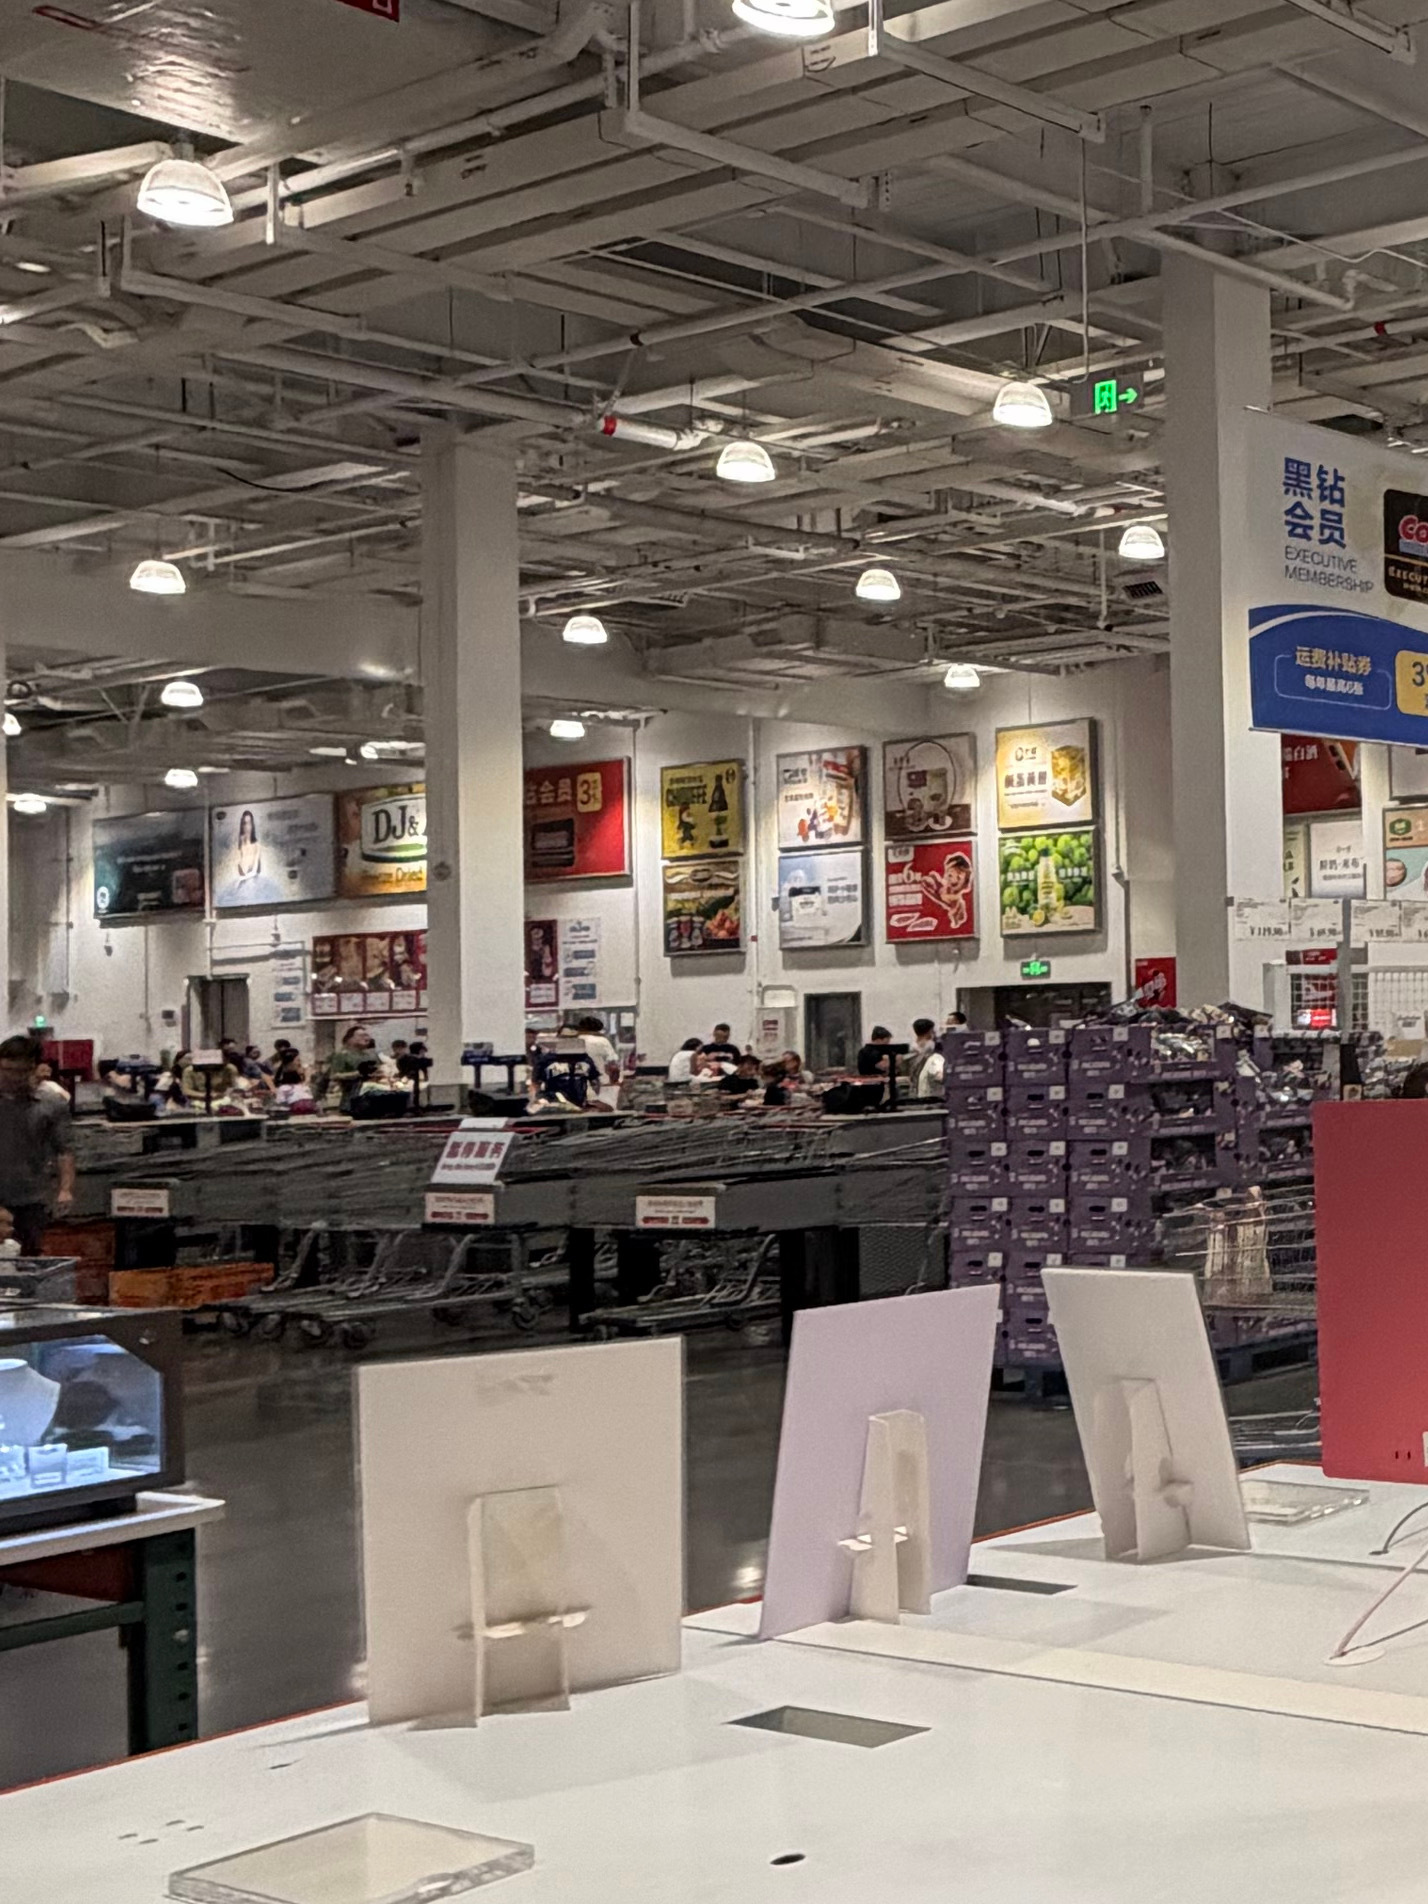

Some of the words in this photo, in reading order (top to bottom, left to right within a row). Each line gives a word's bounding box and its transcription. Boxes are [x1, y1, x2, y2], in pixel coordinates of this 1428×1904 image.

[1282, 457, 1346, 508] 黑钻
[1284, 501, 1346, 549] 会员
[1284, 546, 1358, 573] EXECUTIVE
[1284, 564, 1374, 594] MEMBERSHIP
[372, 804, 426, 845] DJ&
